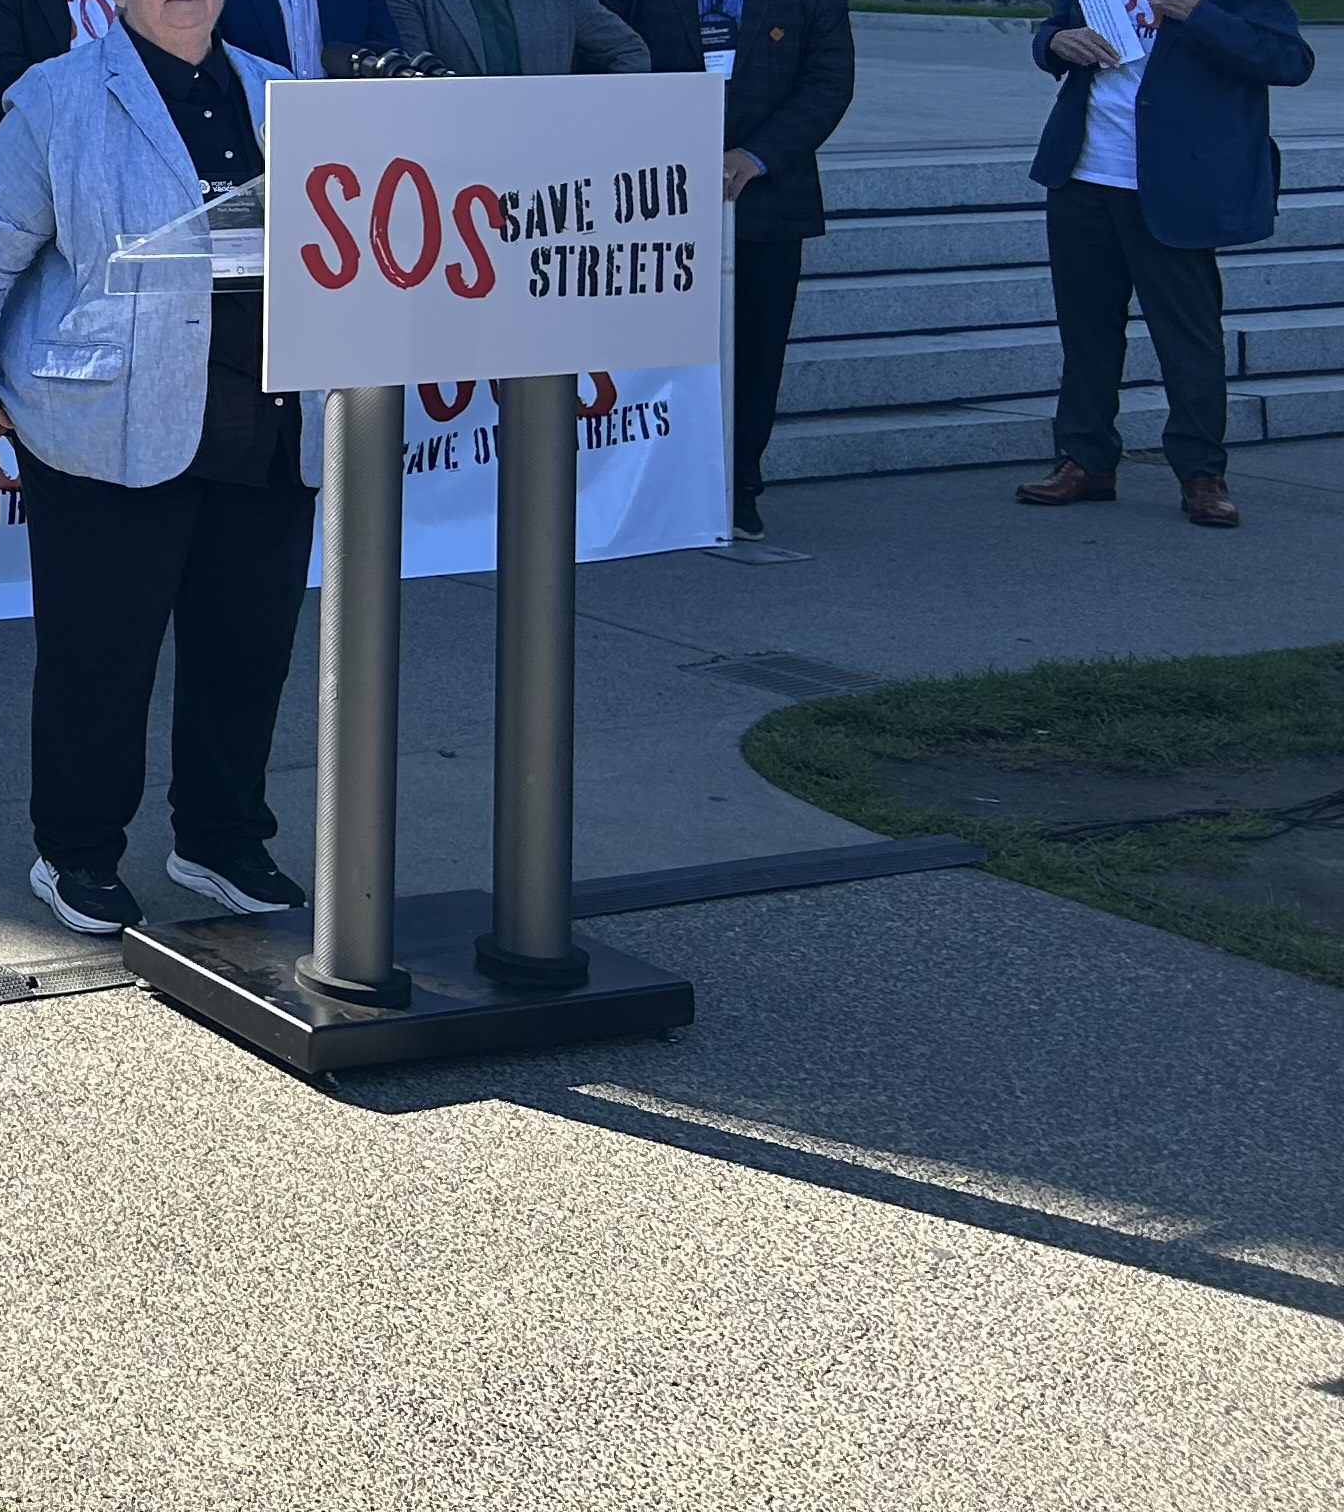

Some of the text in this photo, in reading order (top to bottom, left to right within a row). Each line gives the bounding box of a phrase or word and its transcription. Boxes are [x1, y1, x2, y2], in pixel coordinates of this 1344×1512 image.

[300, 157, 504, 299] SOS
[498, 163, 689, 244] SAVE OUR
[529, 240, 696, 299] STREETS
[402, 432, 460, 475] AVE
[576, 399, 670, 450] REETS
